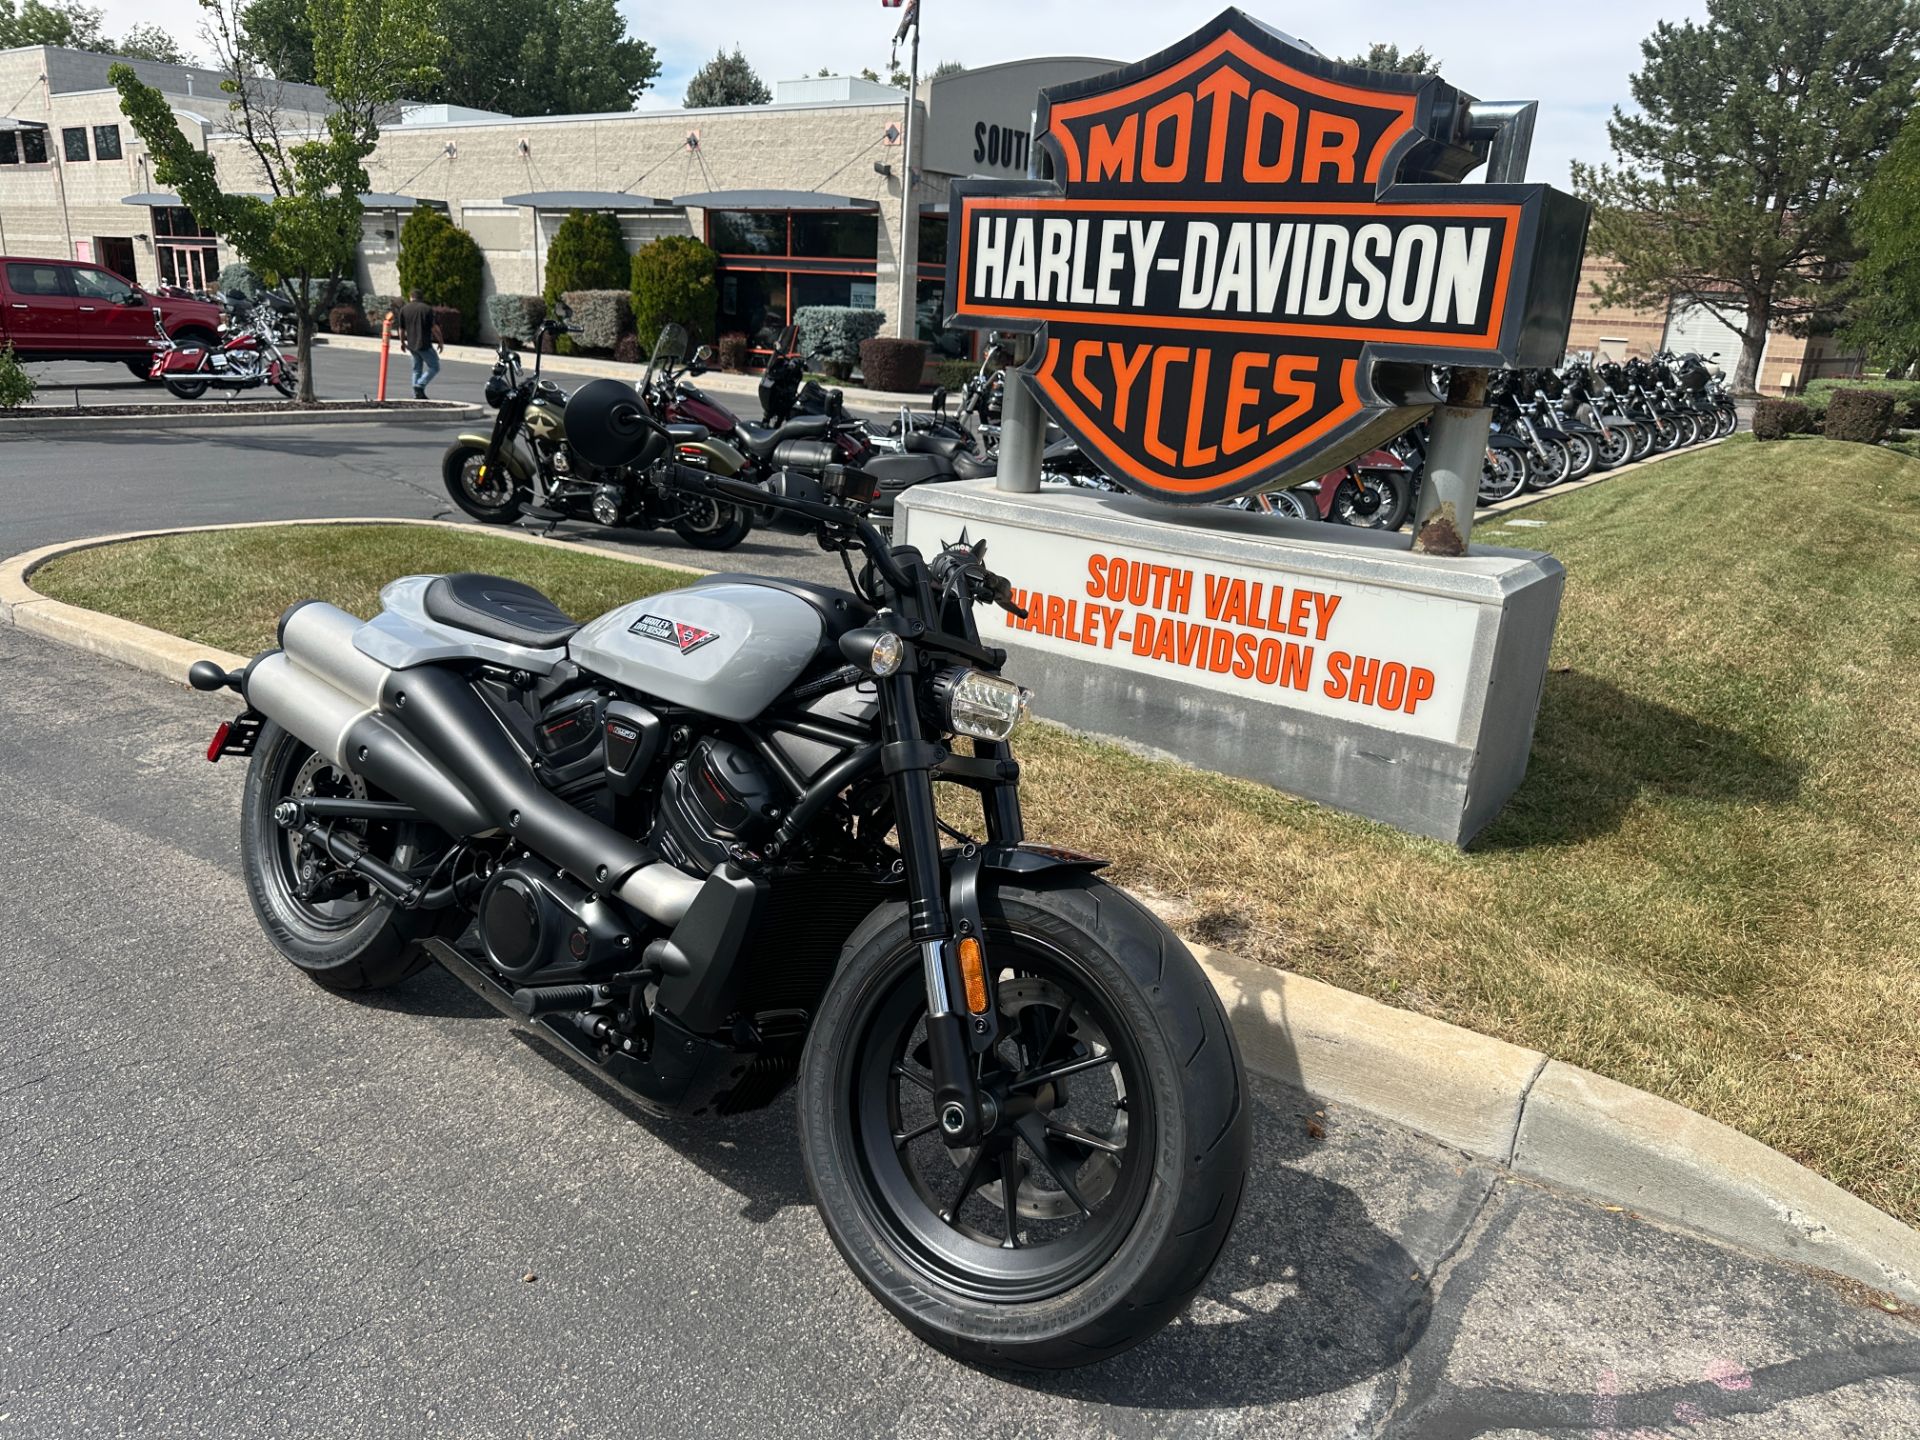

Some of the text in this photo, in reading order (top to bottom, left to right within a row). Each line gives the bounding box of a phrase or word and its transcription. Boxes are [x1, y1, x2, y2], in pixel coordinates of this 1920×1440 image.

[1086, 67, 1359, 183] MOTOR
[973, 216, 1492, 325] HARLEY-DAVIDSON
[1072, 340, 1319, 467] CYCLES
[633, 622, 672, 638] DAVIDSON
[642, 616, 671, 629] HARLEY
[1006, 587, 1434, 714] HARLEY-DAVIDSON SHOP
[1086, 554, 1341, 641] SOUTH VALLEY
